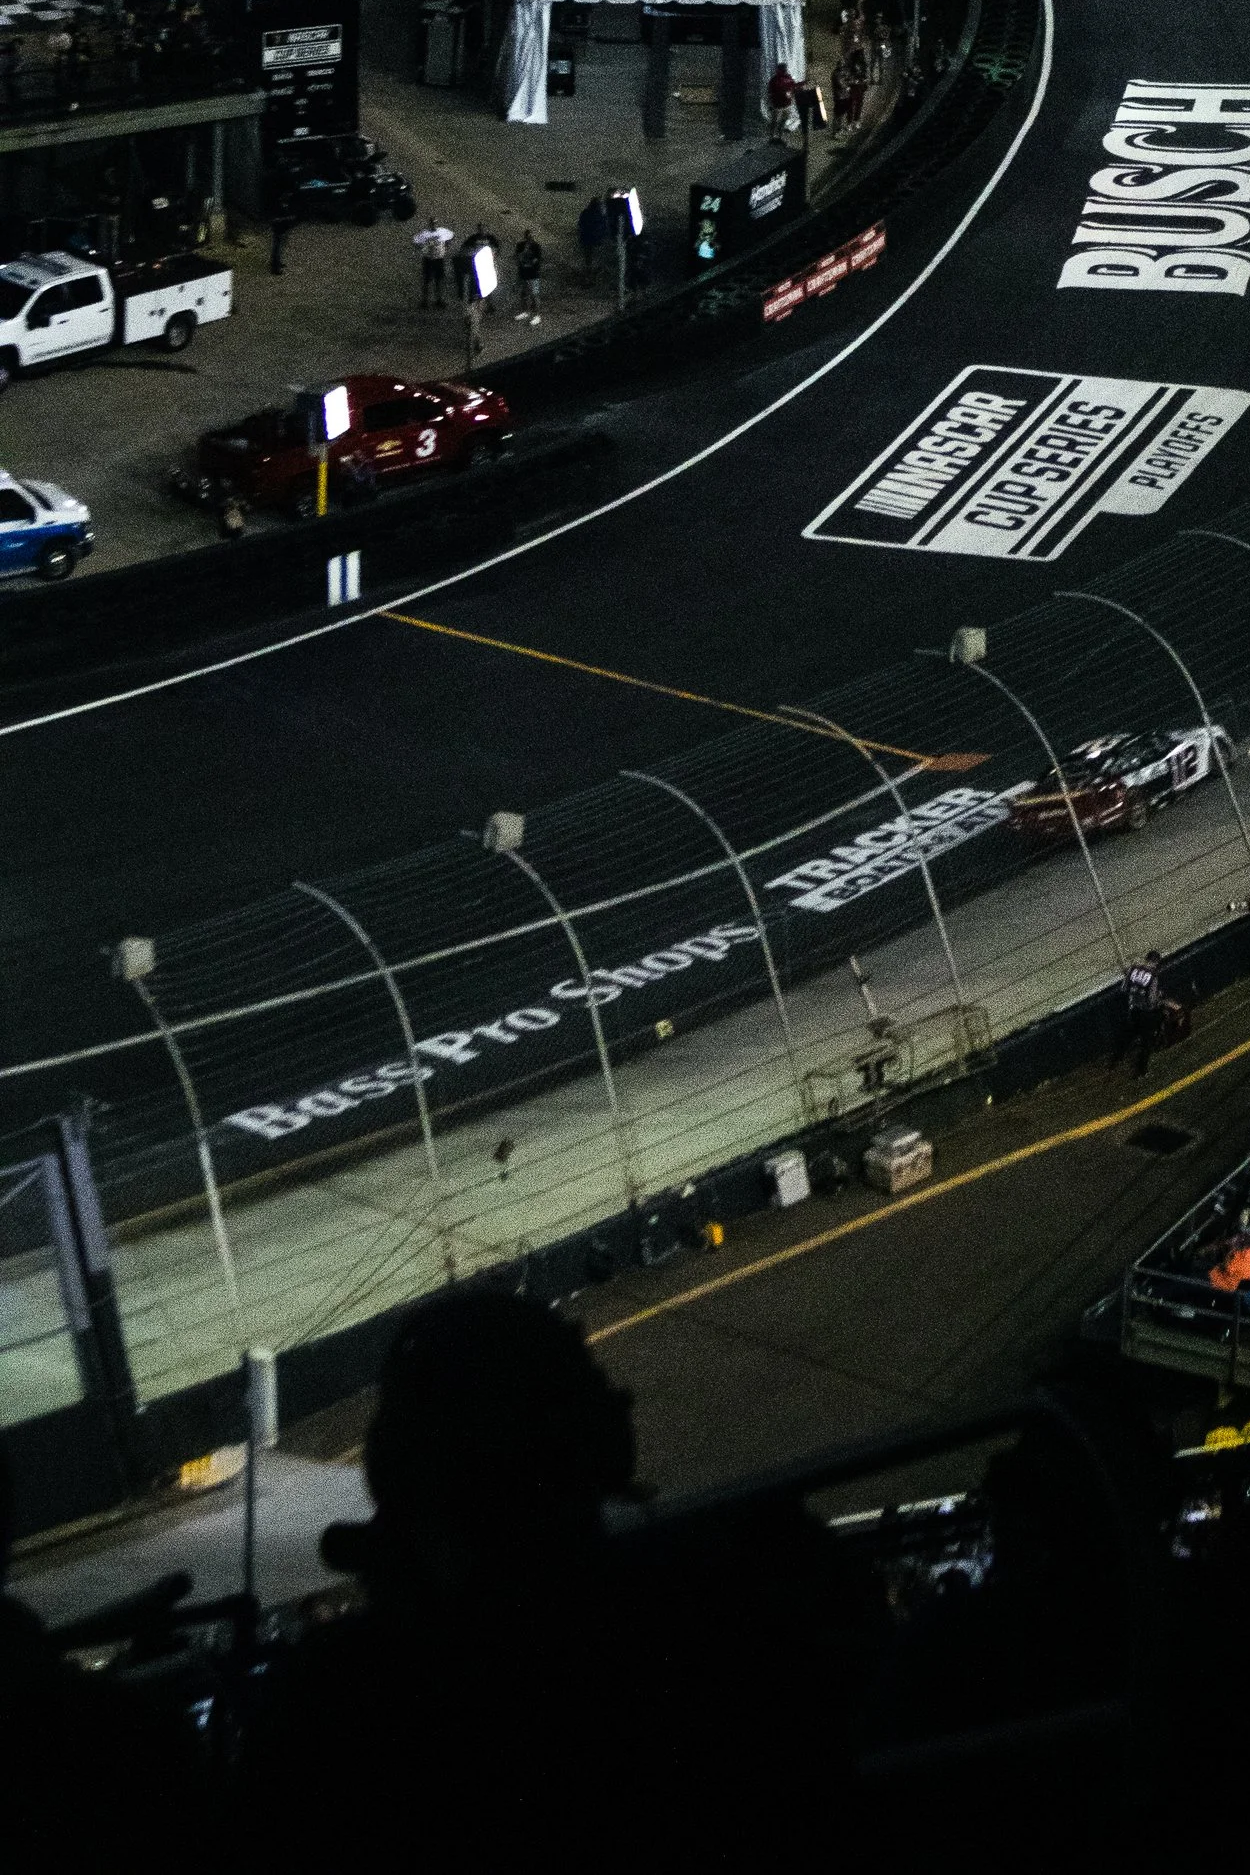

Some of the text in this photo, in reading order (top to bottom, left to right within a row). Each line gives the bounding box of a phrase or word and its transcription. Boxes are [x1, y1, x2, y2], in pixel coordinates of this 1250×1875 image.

[415, 428, 438, 458] 3
[880, 390, 1028, 503] NASCAR
[964, 399, 1127, 531] CUP SERIES
[1129, 410, 1225, 491] PLAYOFFS
[762, 786, 997, 891] TRACKER
[221, 921, 763, 1141] Bass Pro Shops
